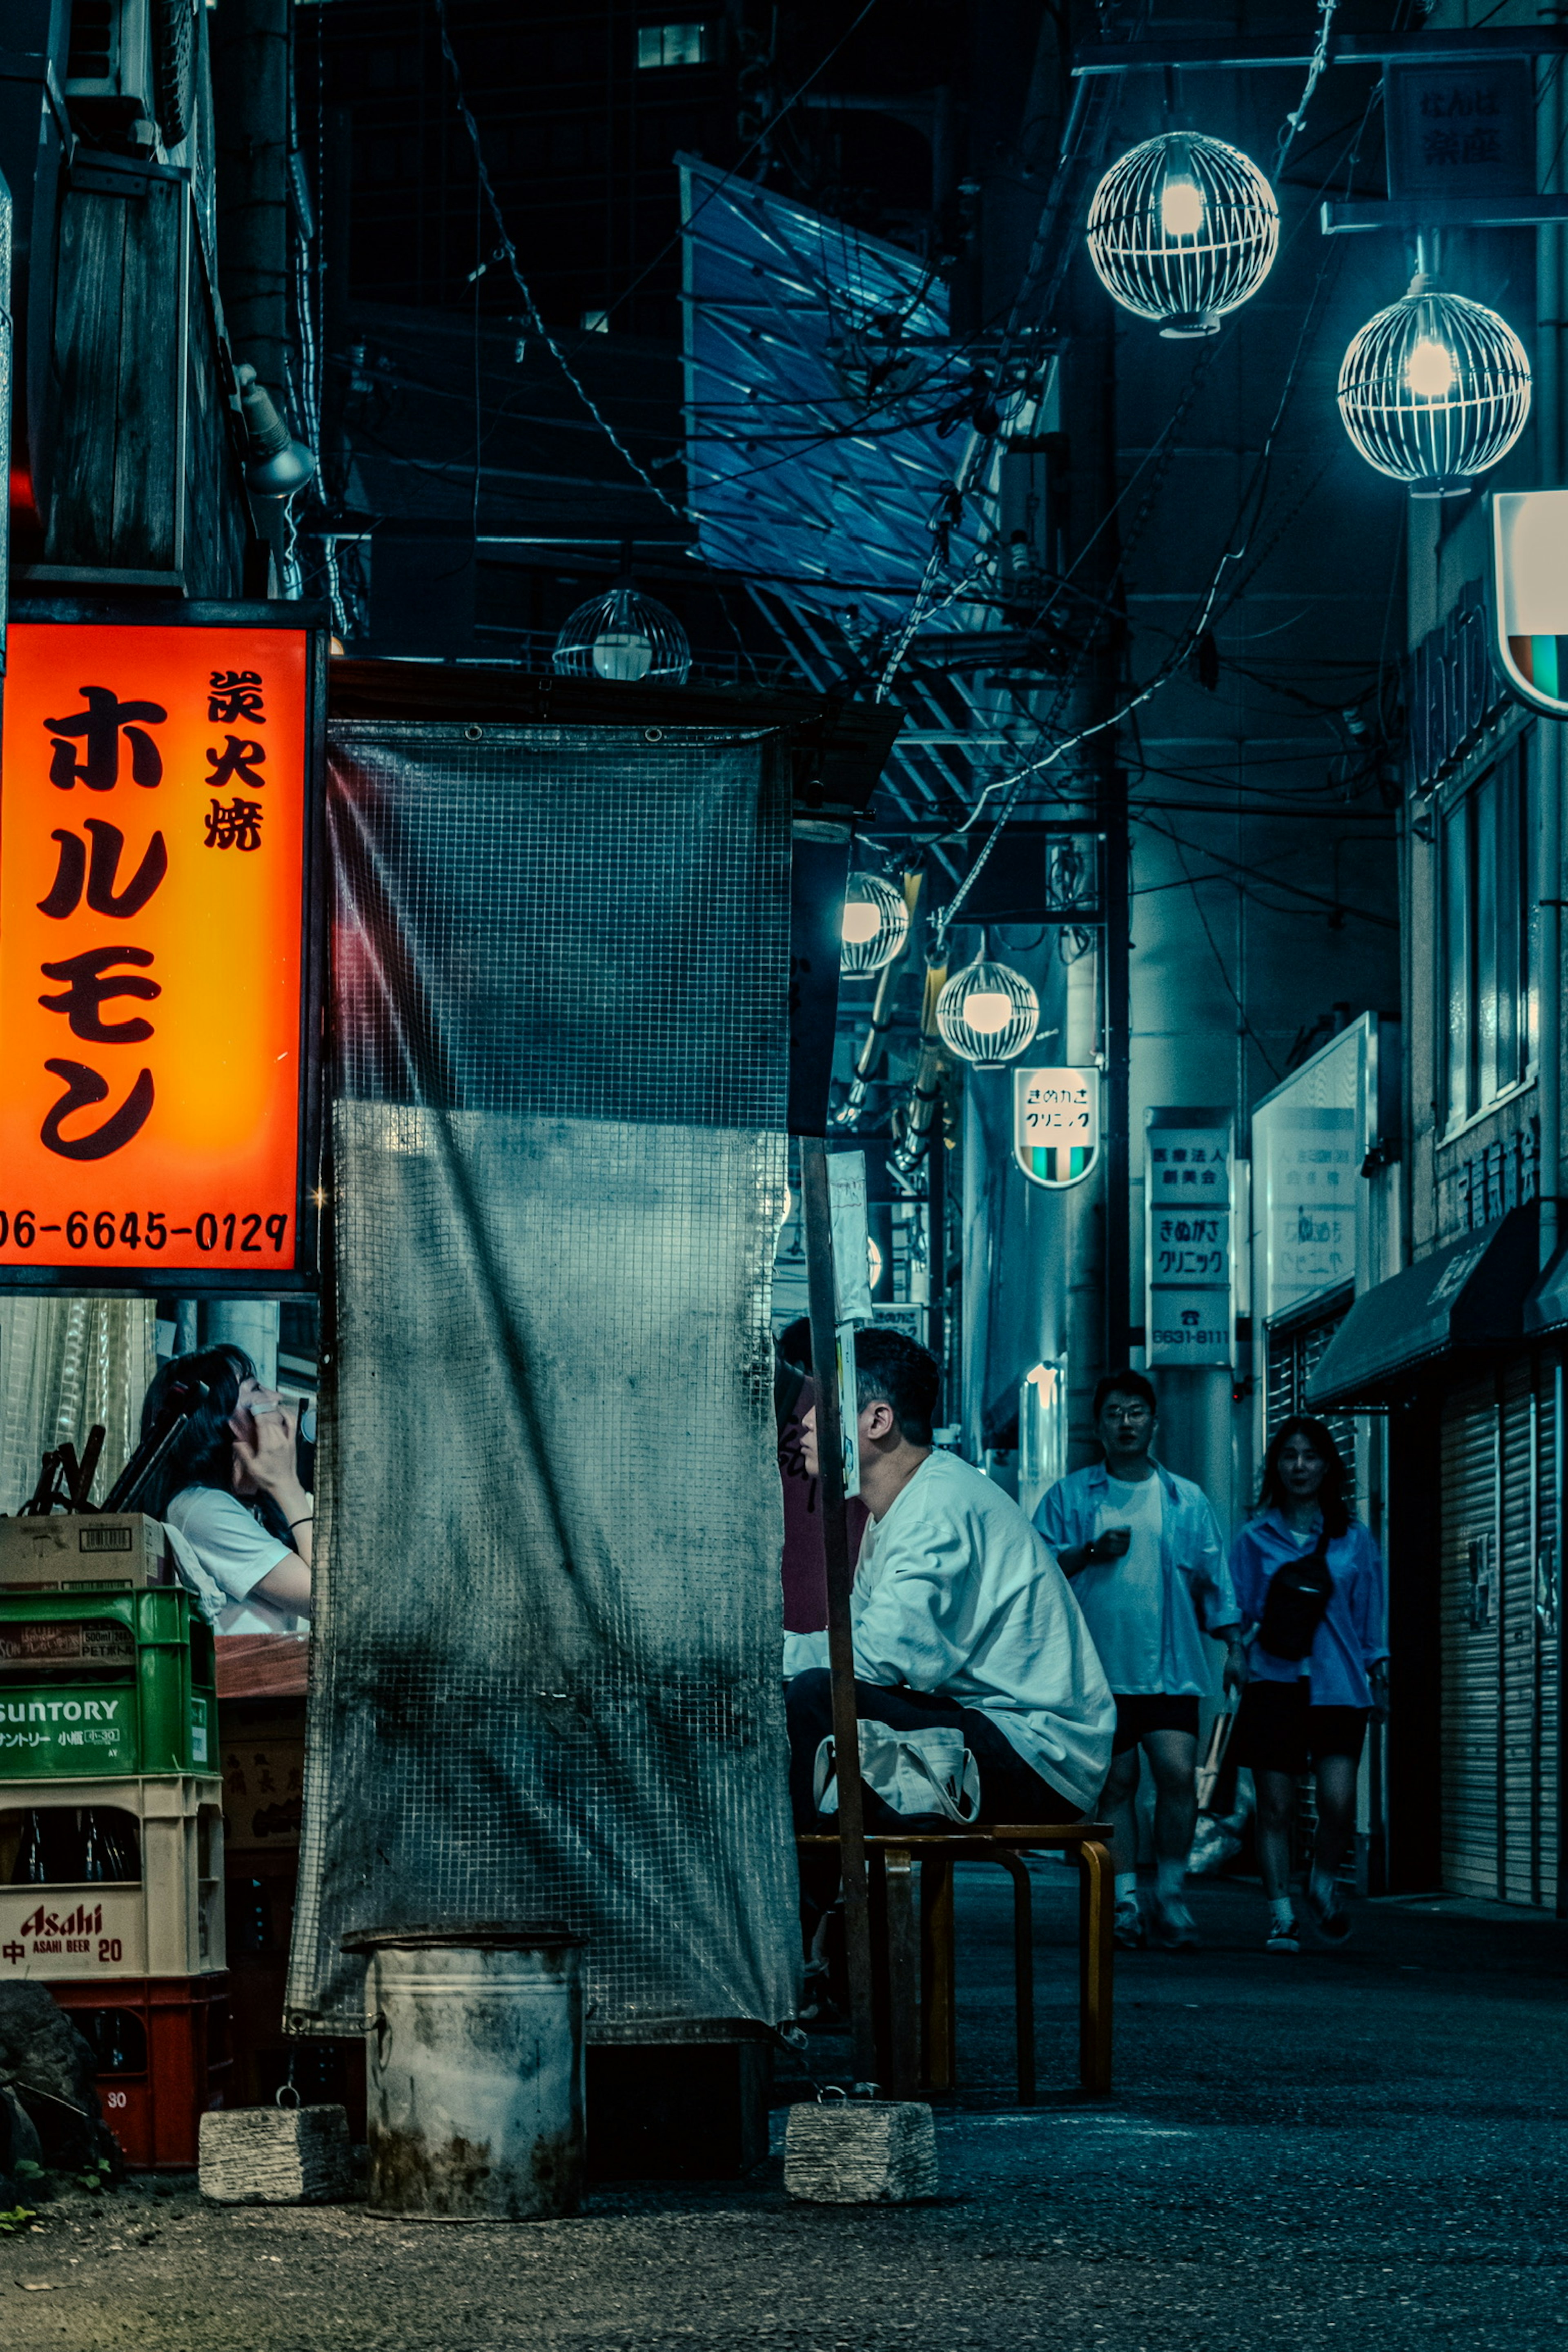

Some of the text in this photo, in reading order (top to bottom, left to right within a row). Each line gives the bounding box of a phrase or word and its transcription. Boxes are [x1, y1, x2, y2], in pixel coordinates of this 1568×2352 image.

[204, 671, 266, 851] 炭火焼
[36, 686, 167, 1160] ホルモン
[1153, 1148, 1225, 1163] 医療法人
[1160, 1219, 1219, 1243] きぬがさ
[1159, 1250, 1223, 1273] クリニック
[1152, 1329, 1229, 1344] 6631-8111
[86, 1632, 111, 1642] 500ml
[20, 1903, 102, 1938] Asahi
[2, 1938, 122, 1965] 中 ASAHI BEER 20
[108, 2091, 127, 2108] 30
